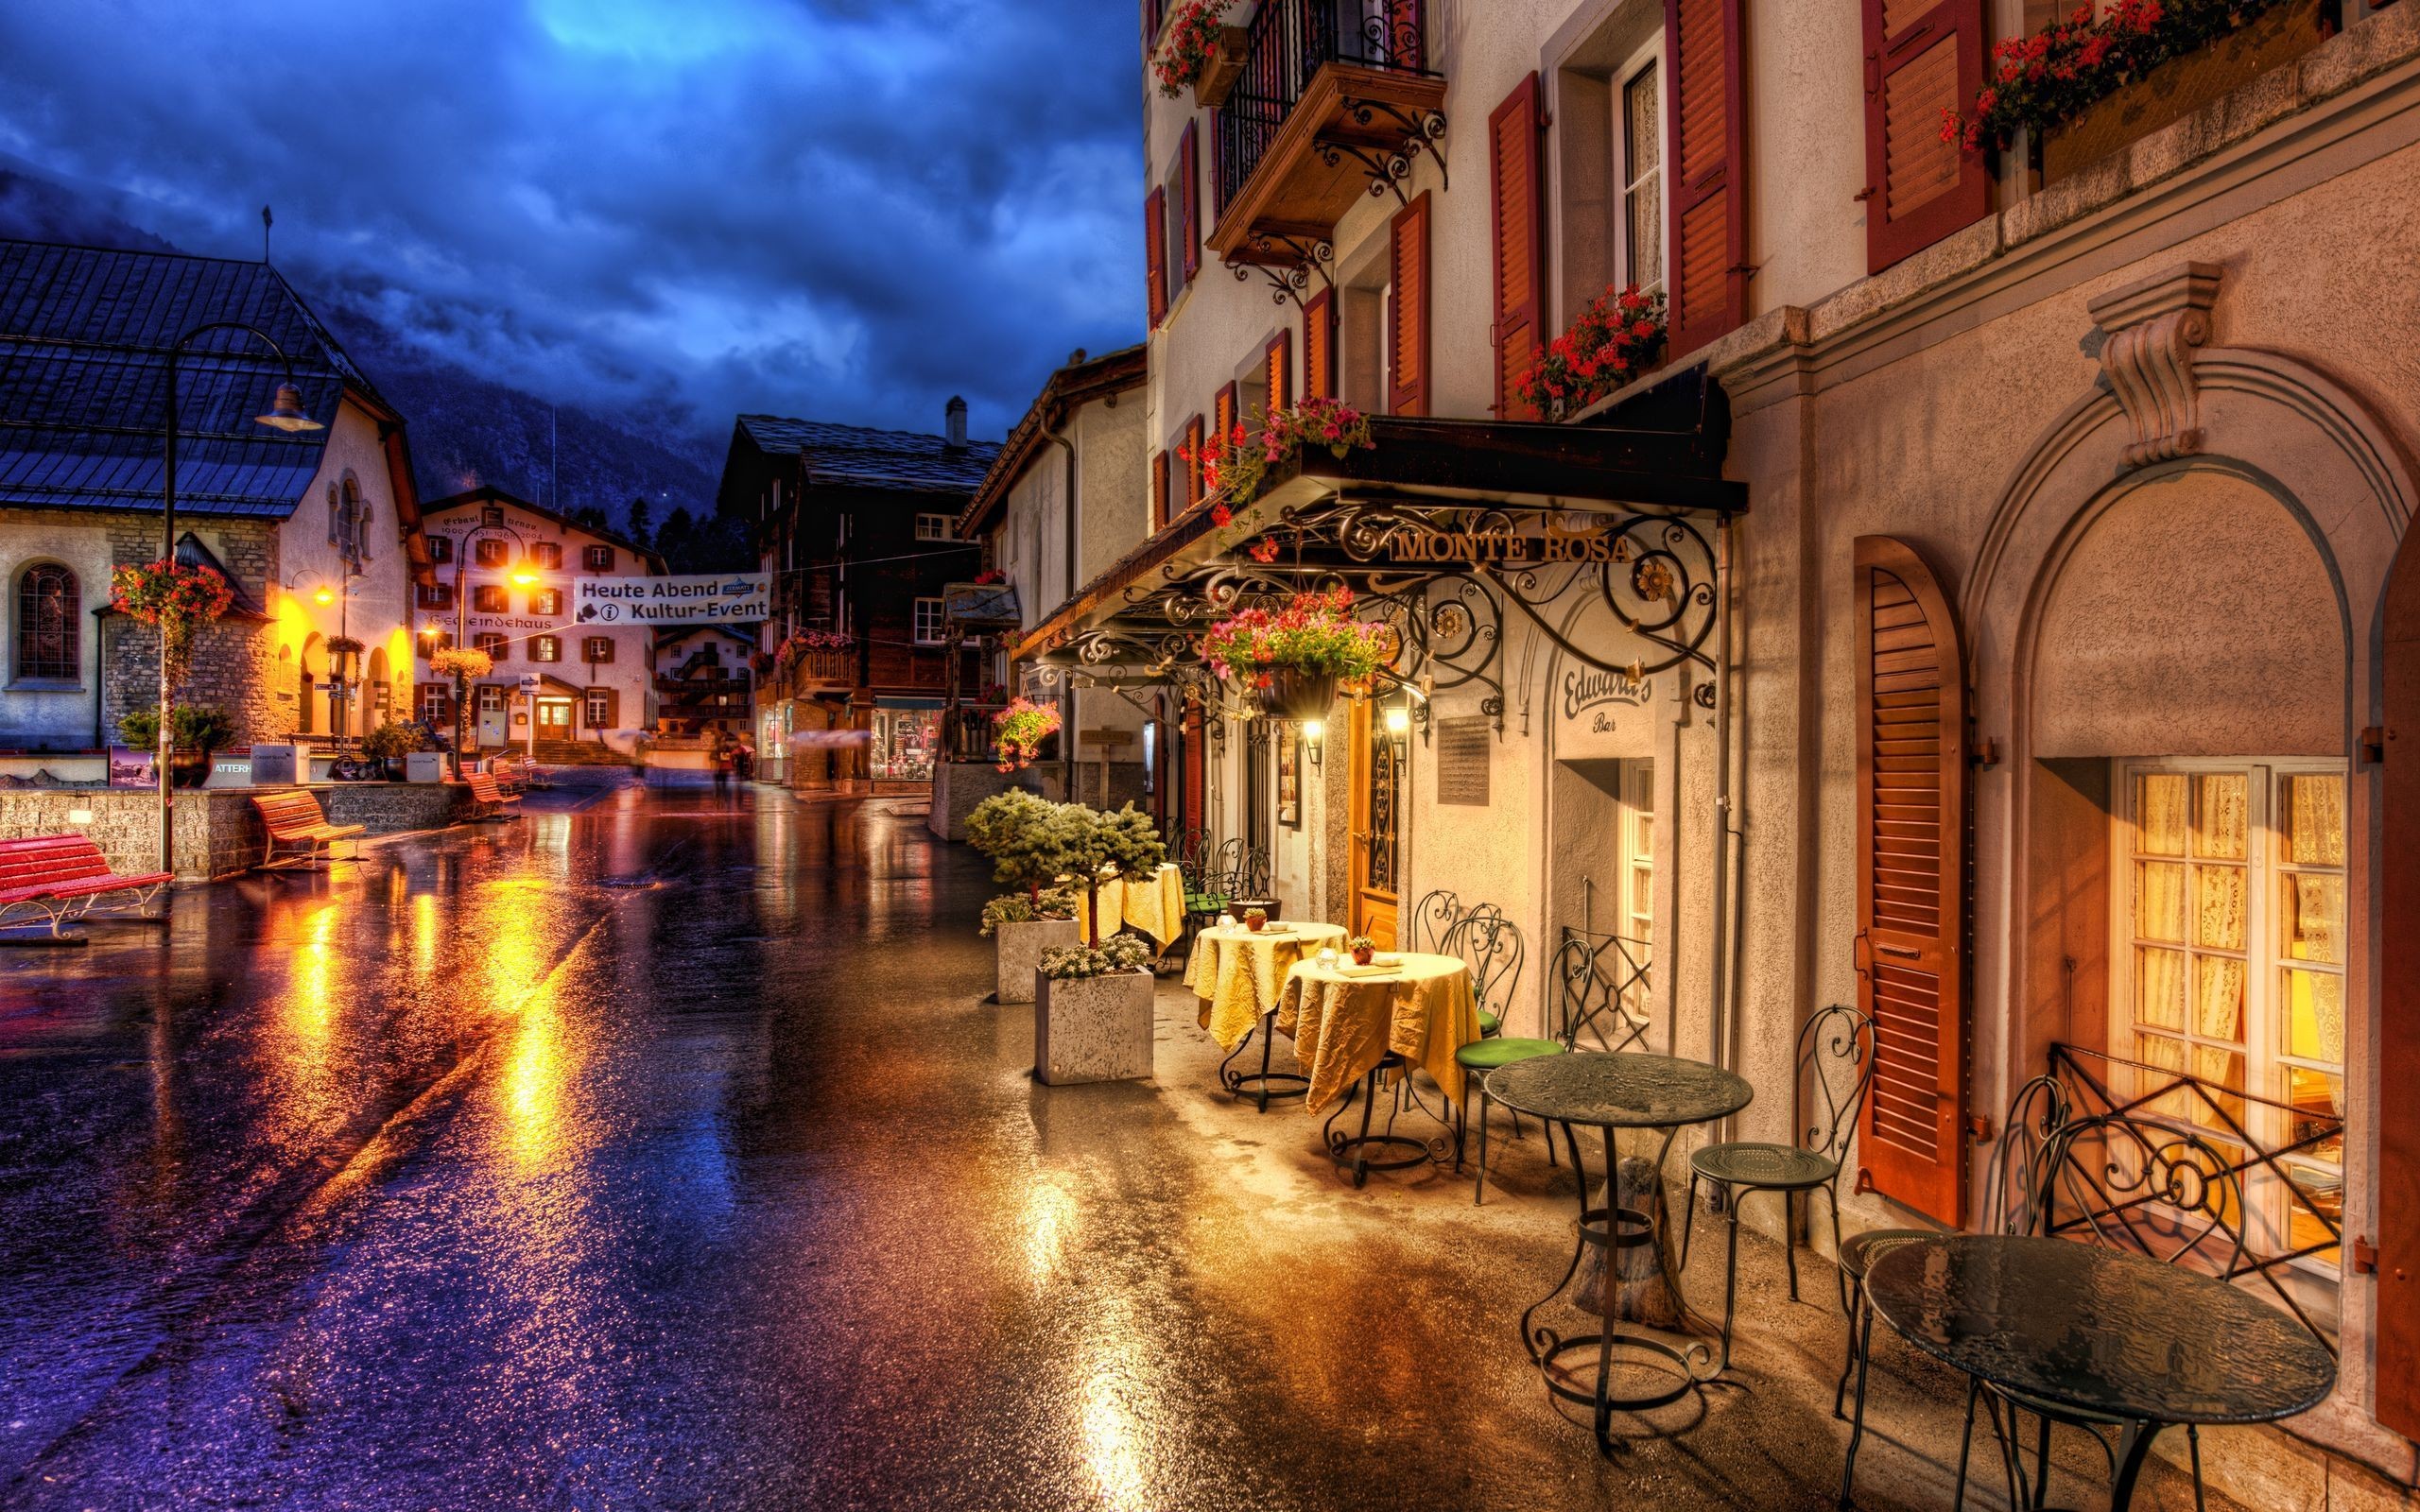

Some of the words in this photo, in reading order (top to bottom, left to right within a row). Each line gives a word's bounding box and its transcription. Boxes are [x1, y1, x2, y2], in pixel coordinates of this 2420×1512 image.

[1395, 533, 1528, 561] MONTE
[1542, 536, 1634, 563] ROSA
[582, 583, 645, 597] Heute
[652, 580, 717, 597] Abend
[631, 601, 767, 619] Kultur-Event
[1592, 712, 1616, 733] Bar
